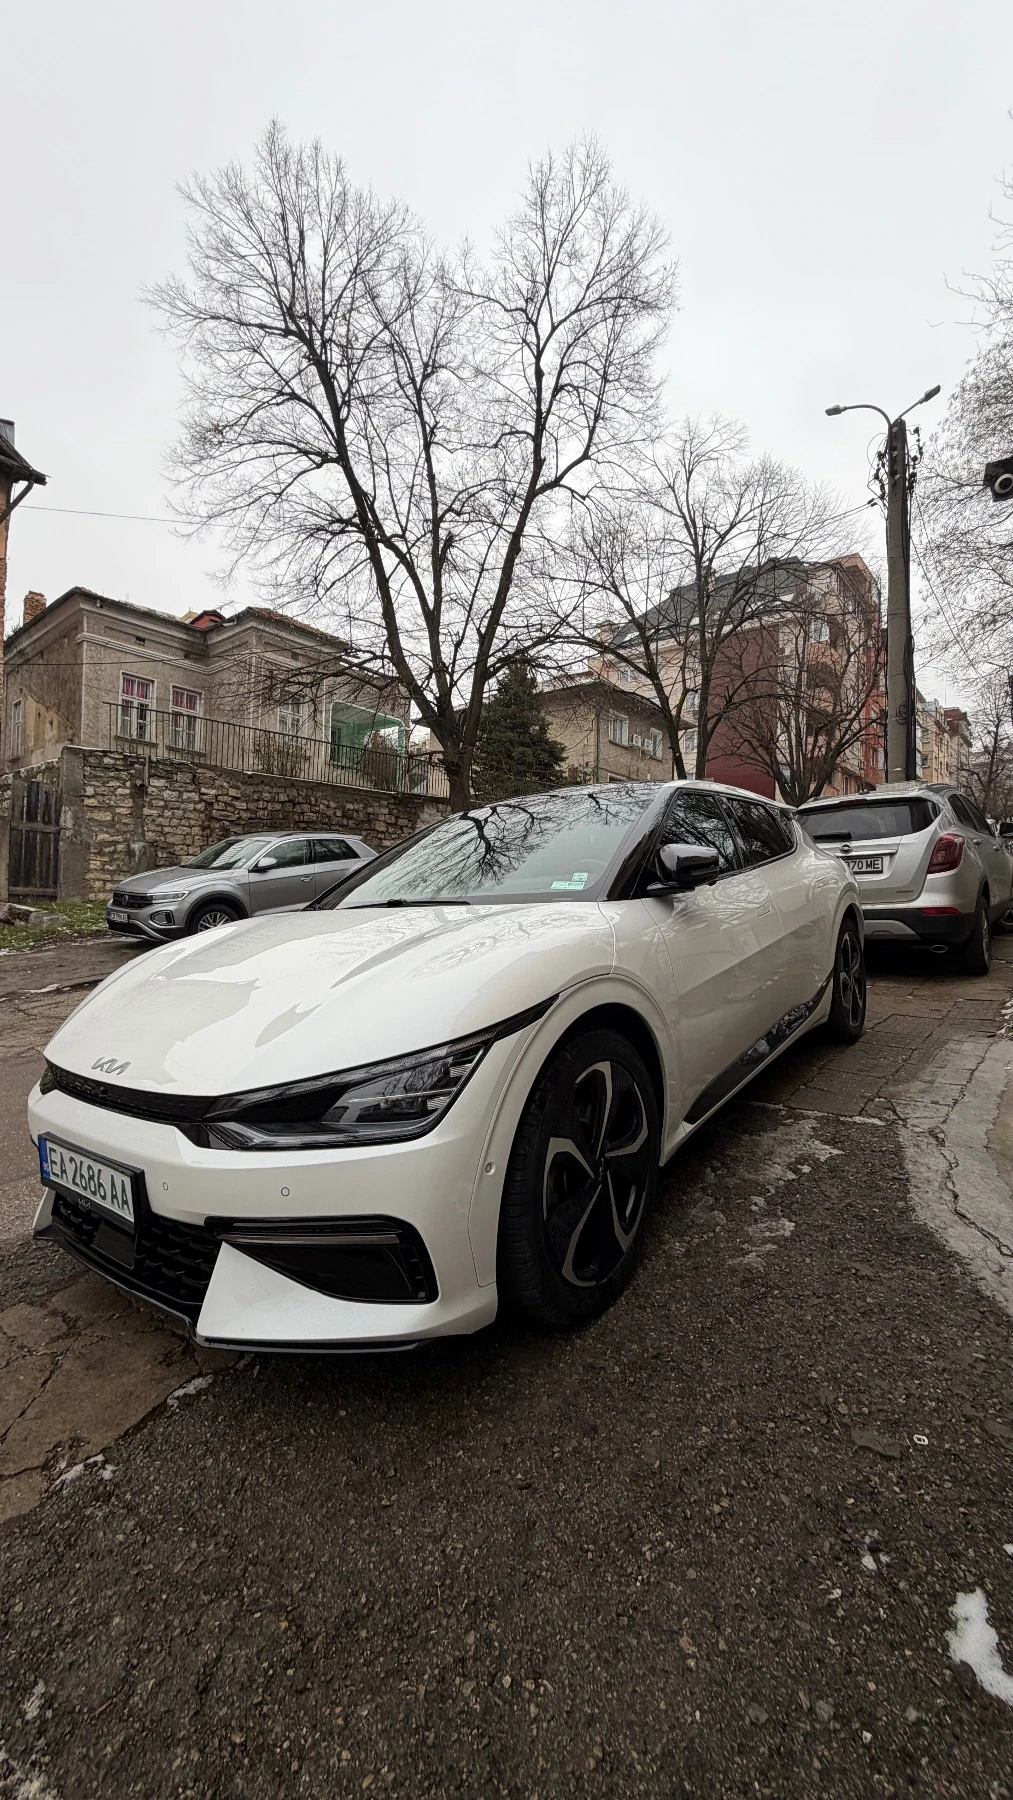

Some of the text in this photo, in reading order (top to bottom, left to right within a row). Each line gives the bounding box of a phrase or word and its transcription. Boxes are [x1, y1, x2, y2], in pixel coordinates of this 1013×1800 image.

[866, 860, 880, 870] ME
[91, 1056, 131, 1075] KIA
[49, 1146, 132, 1216] EA 2686 AA
